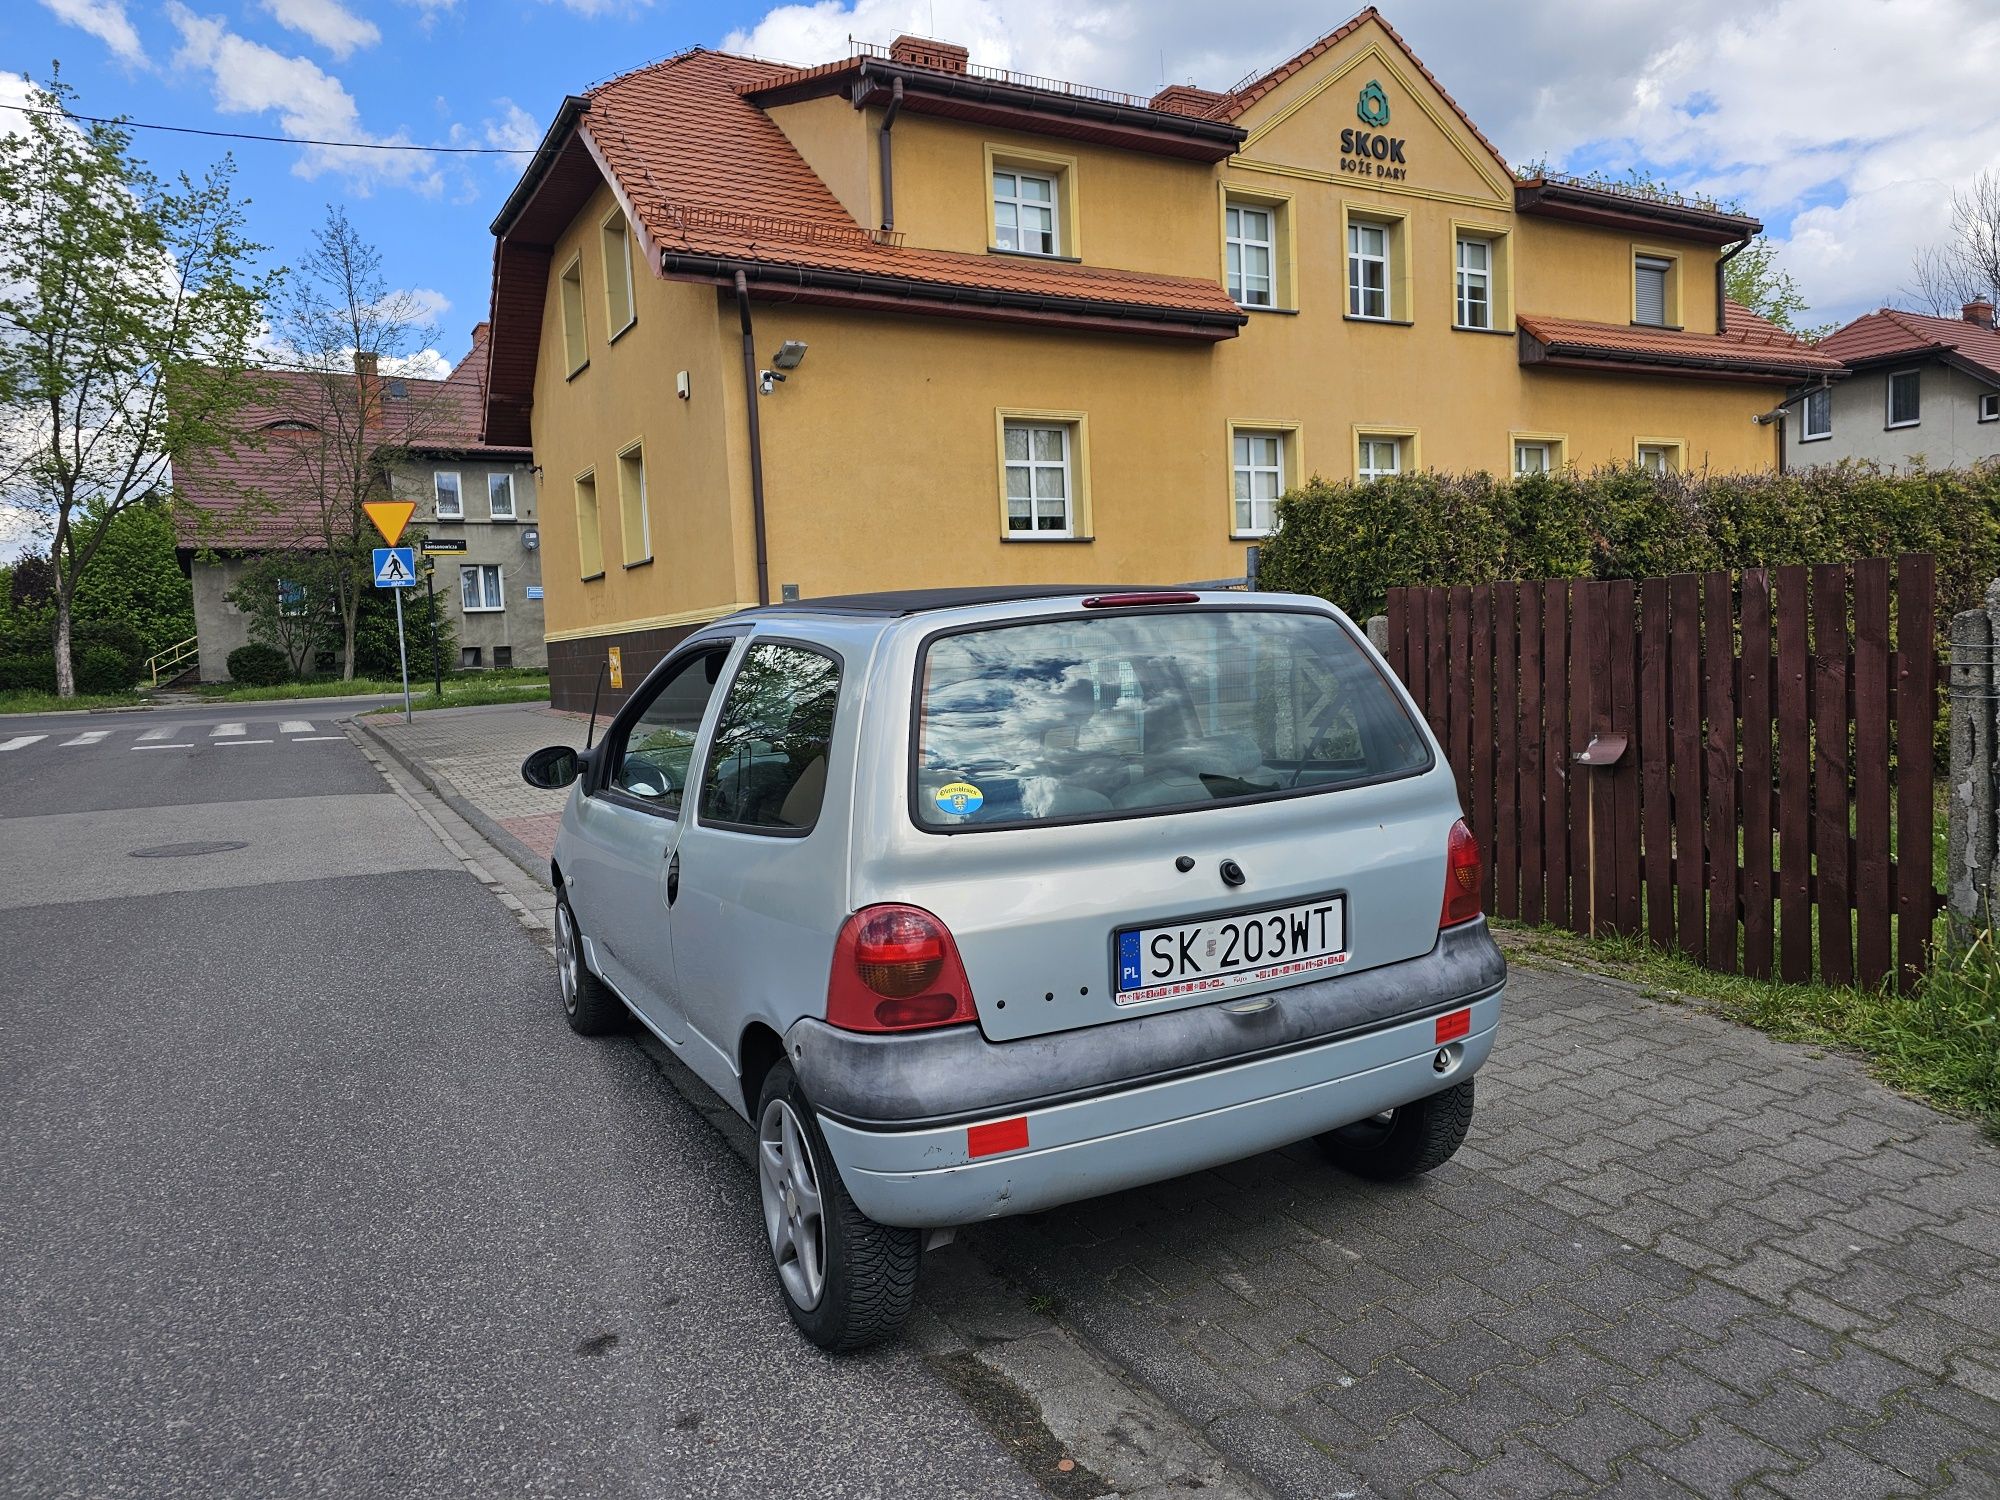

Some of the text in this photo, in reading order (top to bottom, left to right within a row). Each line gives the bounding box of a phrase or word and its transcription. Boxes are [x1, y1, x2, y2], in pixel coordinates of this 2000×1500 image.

[1341, 128, 1406, 164] SKOK
[1341, 157, 1407, 181] BOŻE DARY
[1150, 906, 1333, 978] SK 203WT
[1123, 966, 1139, 980] PL
